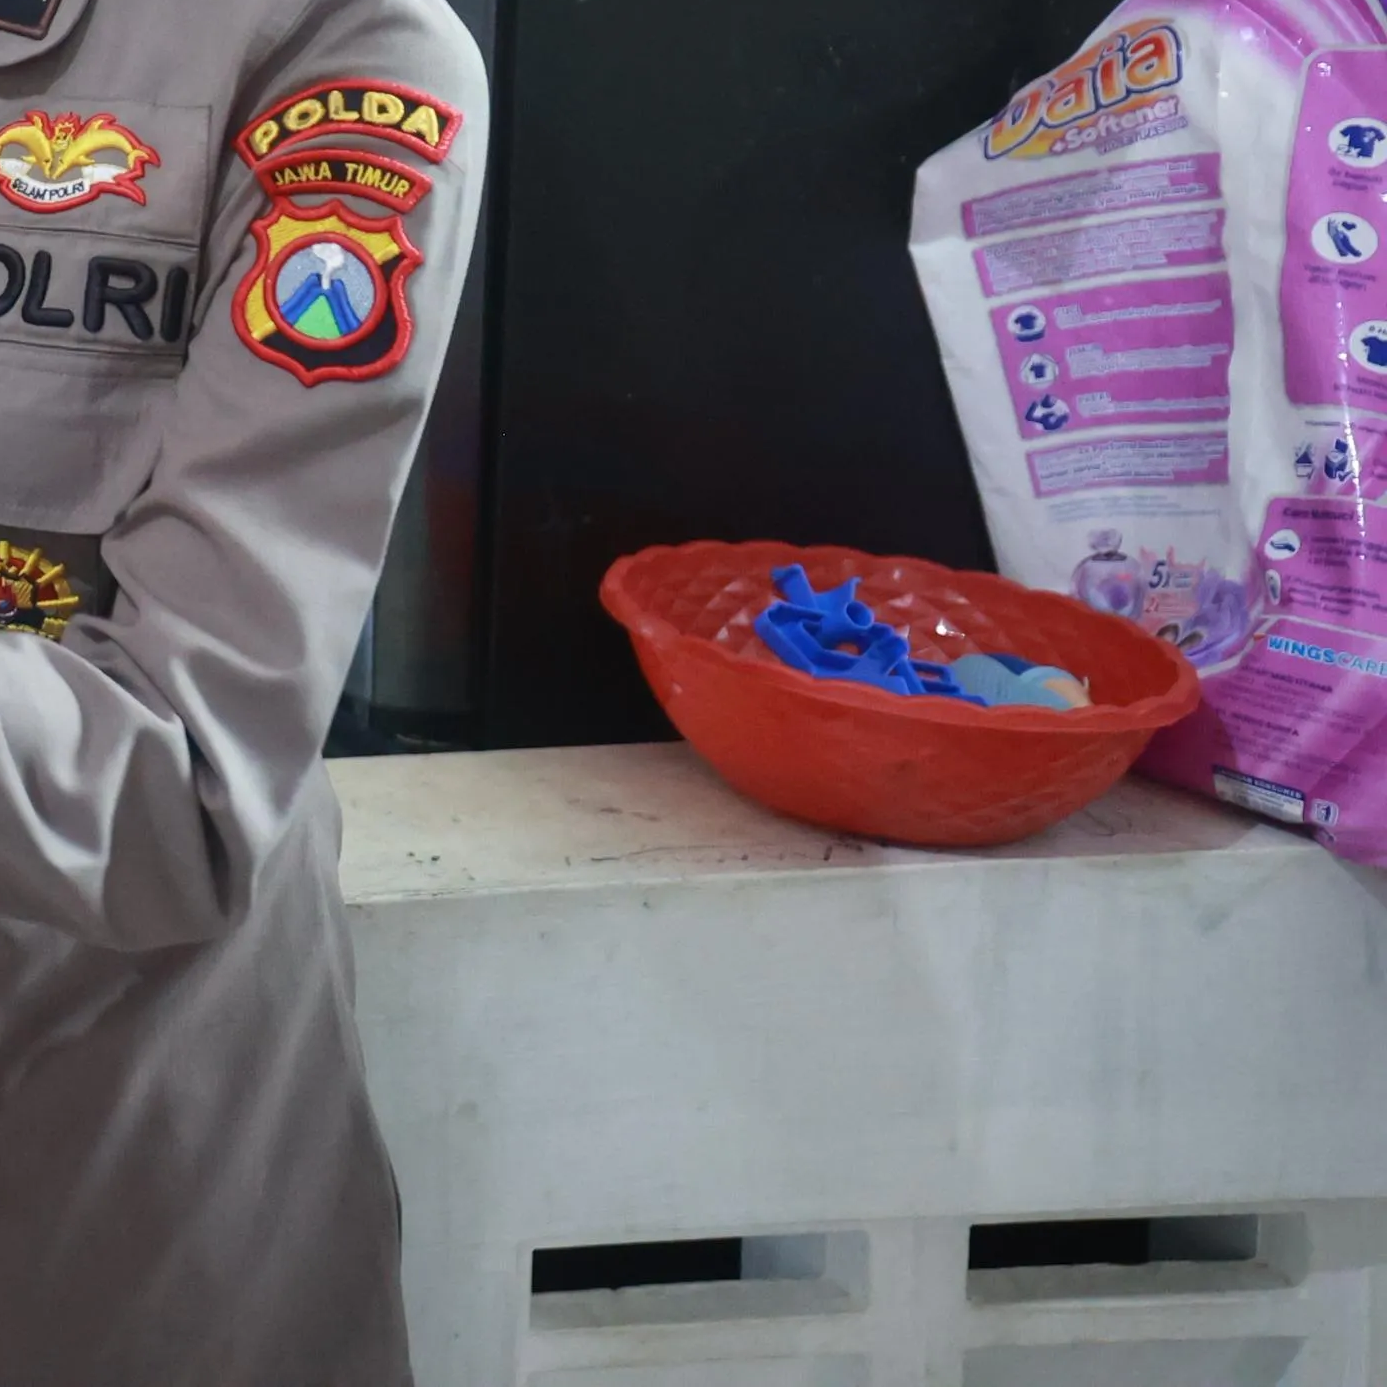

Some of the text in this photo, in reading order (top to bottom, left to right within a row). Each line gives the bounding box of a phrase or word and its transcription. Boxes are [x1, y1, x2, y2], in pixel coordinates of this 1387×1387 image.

[984, 24, 1183, 161] Daia
[248, 89, 440, 157] POLDA
[12, 178, 85, 201] SELAM POLRI
[275, 161, 411, 199] JAWA TIMUR
